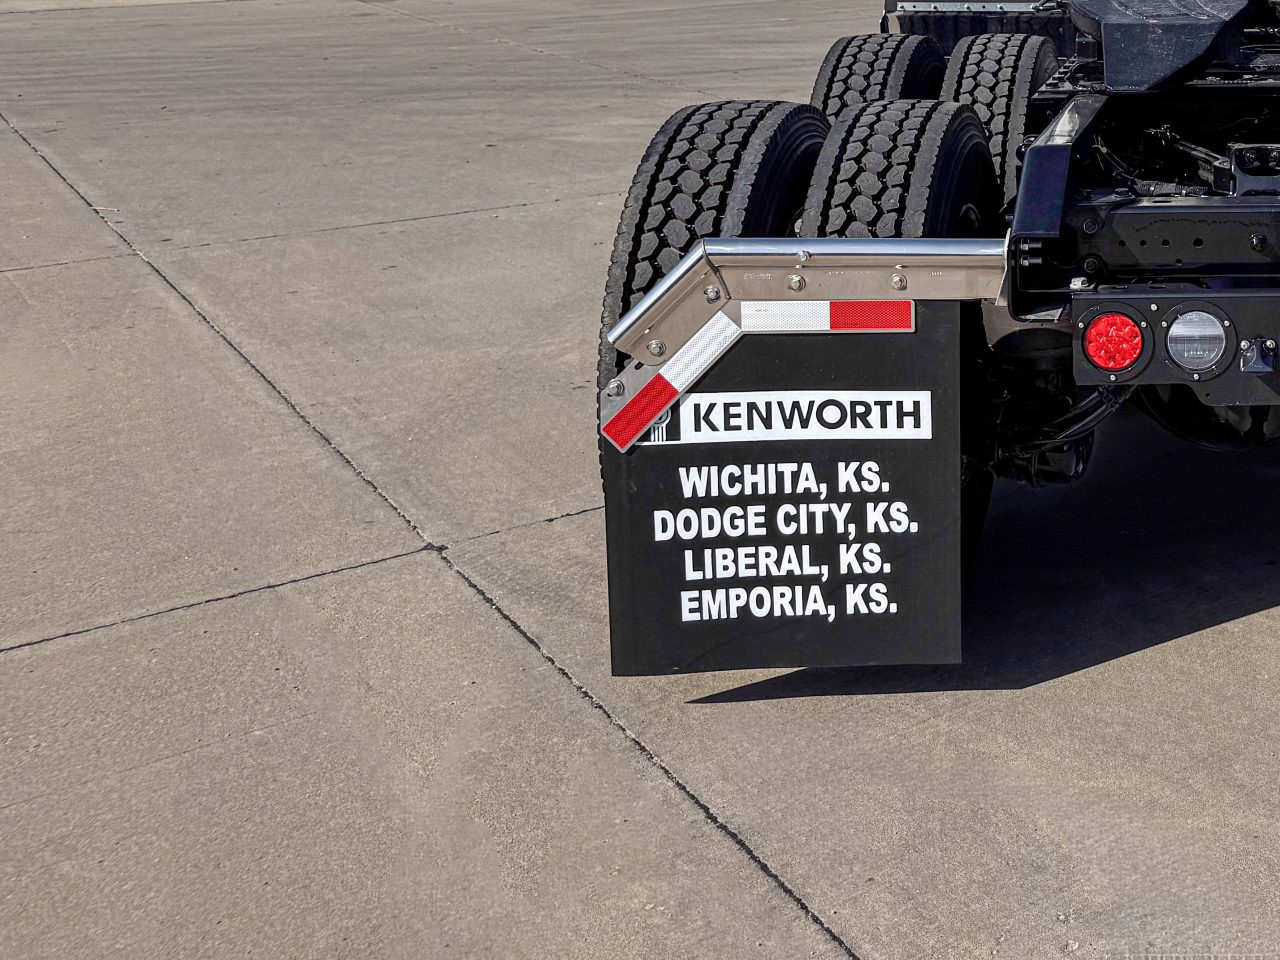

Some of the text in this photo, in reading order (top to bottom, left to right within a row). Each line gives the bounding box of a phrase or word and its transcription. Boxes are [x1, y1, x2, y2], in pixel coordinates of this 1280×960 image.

[693, 398, 921, 433] KENWORTH
[678, 461, 890, 499] WICHITA, KS.
[653, 501, 919, 542] DODGE CITY, KS.
[684, 542, 892, 583] LIBERAL, KS.
[680, 582, 898, 623] EMPORIA, KS.
